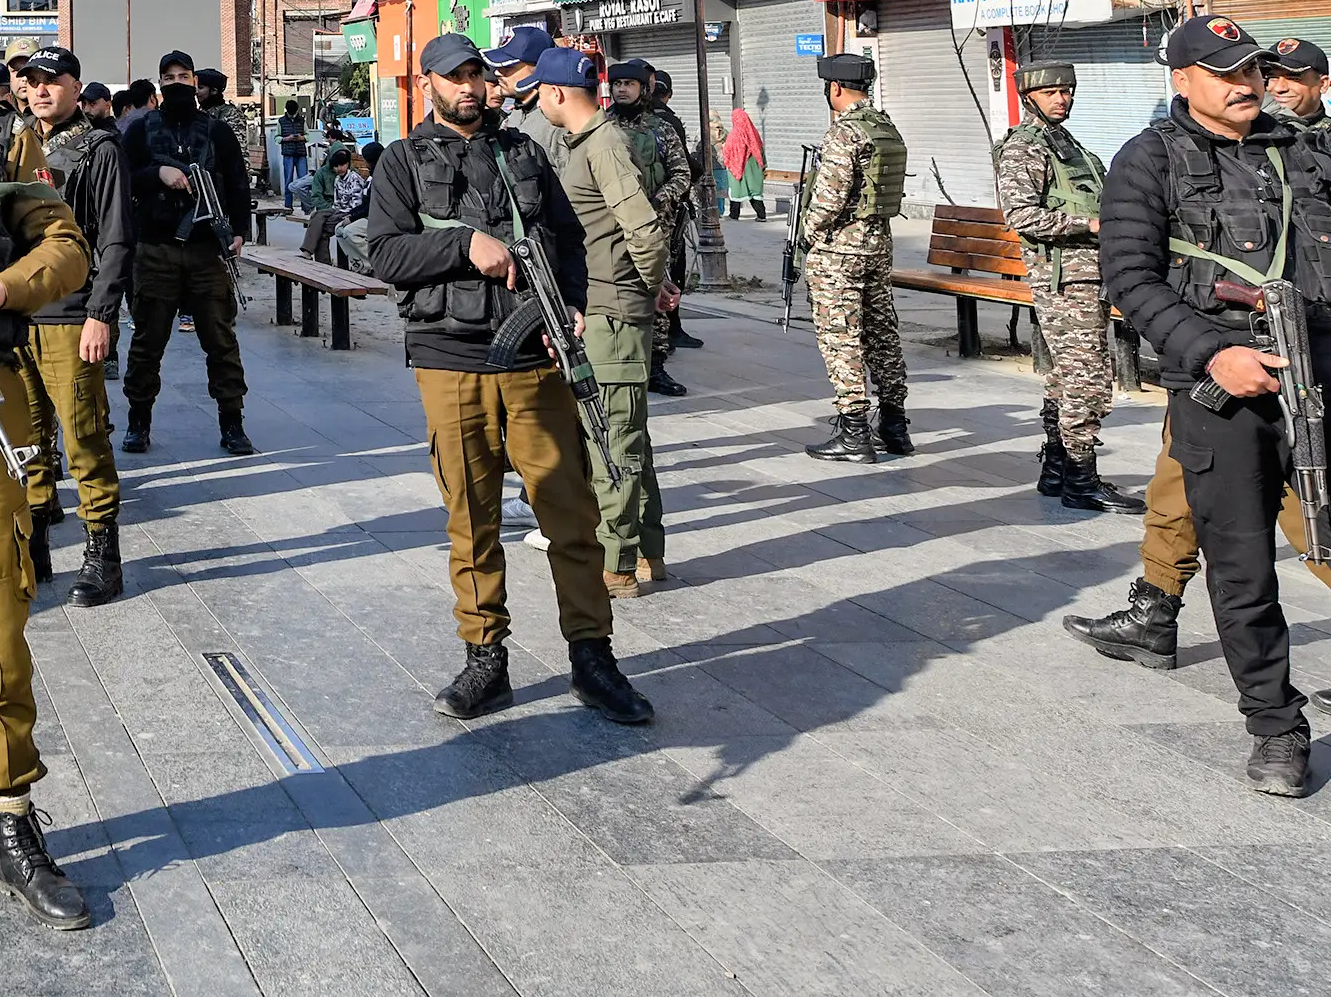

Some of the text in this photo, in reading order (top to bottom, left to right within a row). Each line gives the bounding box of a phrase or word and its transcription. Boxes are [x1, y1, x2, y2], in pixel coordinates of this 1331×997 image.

[1025, 4, 1046, 17] BOOK
[30, 17, 46, 26] BIN
[589, 18, 603, 31] PURE
[616, 12, 653, 28] RESTAURANT
[660, 9, 677, 22] CAFE
